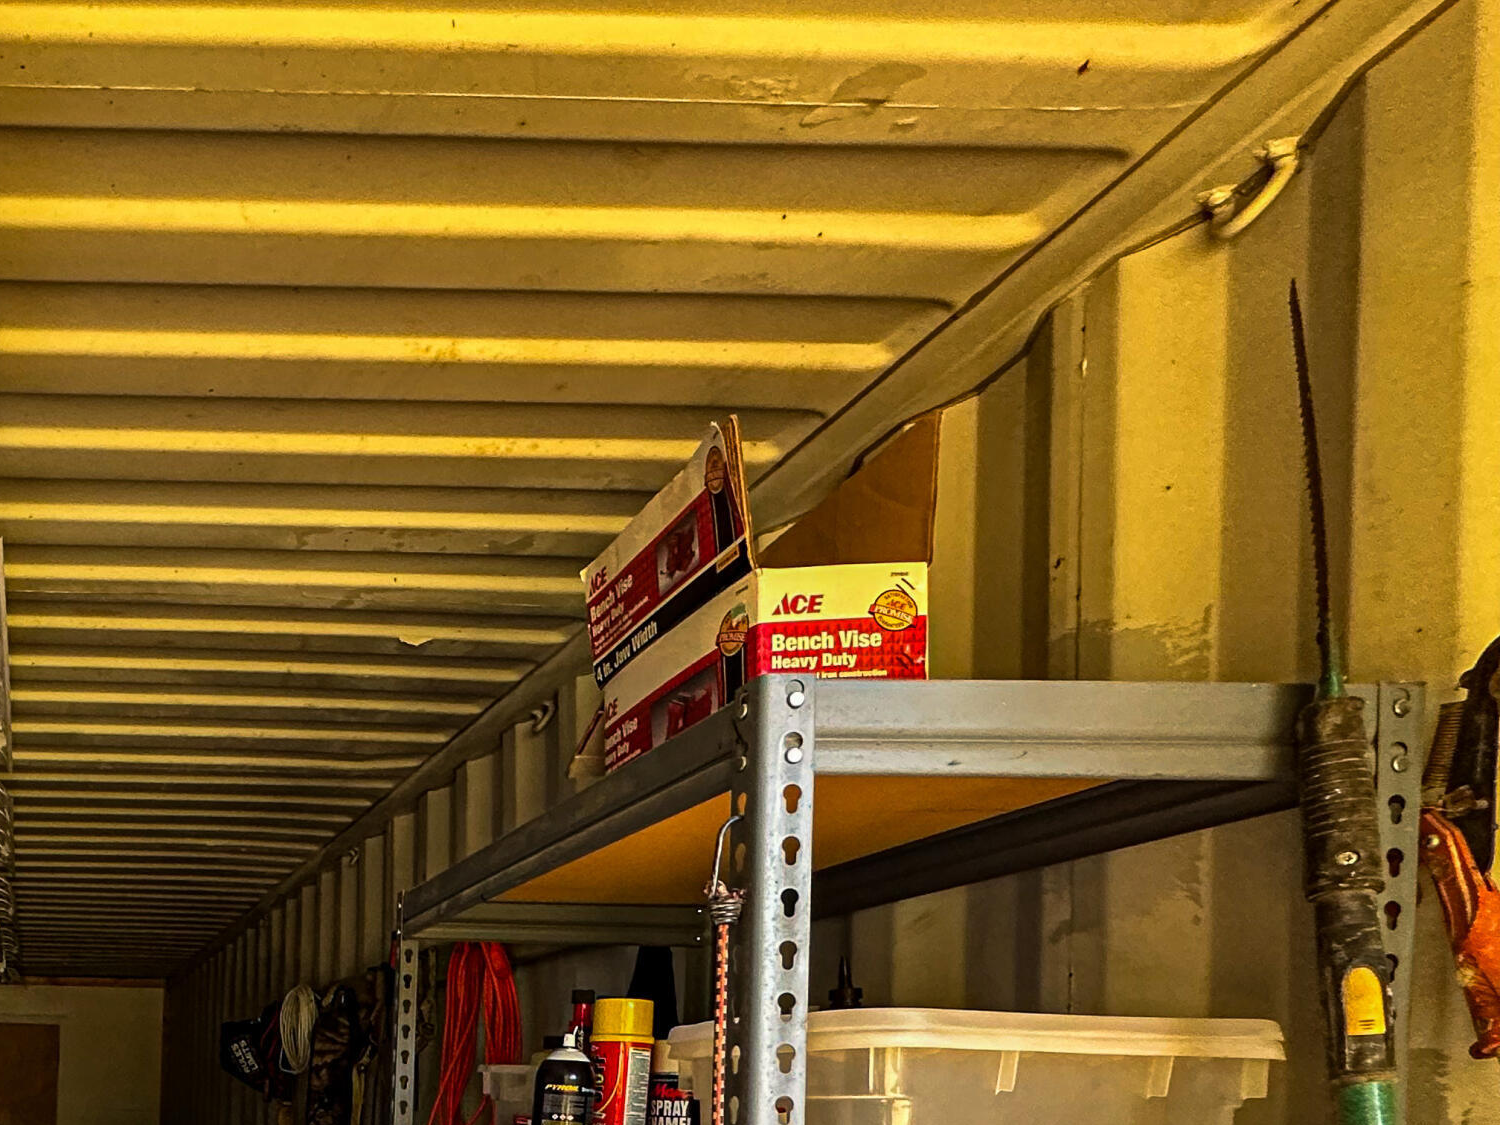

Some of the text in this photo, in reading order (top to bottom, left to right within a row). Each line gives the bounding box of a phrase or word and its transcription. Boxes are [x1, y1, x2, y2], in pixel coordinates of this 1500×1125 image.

[772, 593, 825, 616] ACE
[631, 620, 658, 652] Width
[771, 630, 883, 652] Bench Vise
[771, 652, 858, 670] Heavy Duty
[651, 1101, 690, 1117] SPRAY
